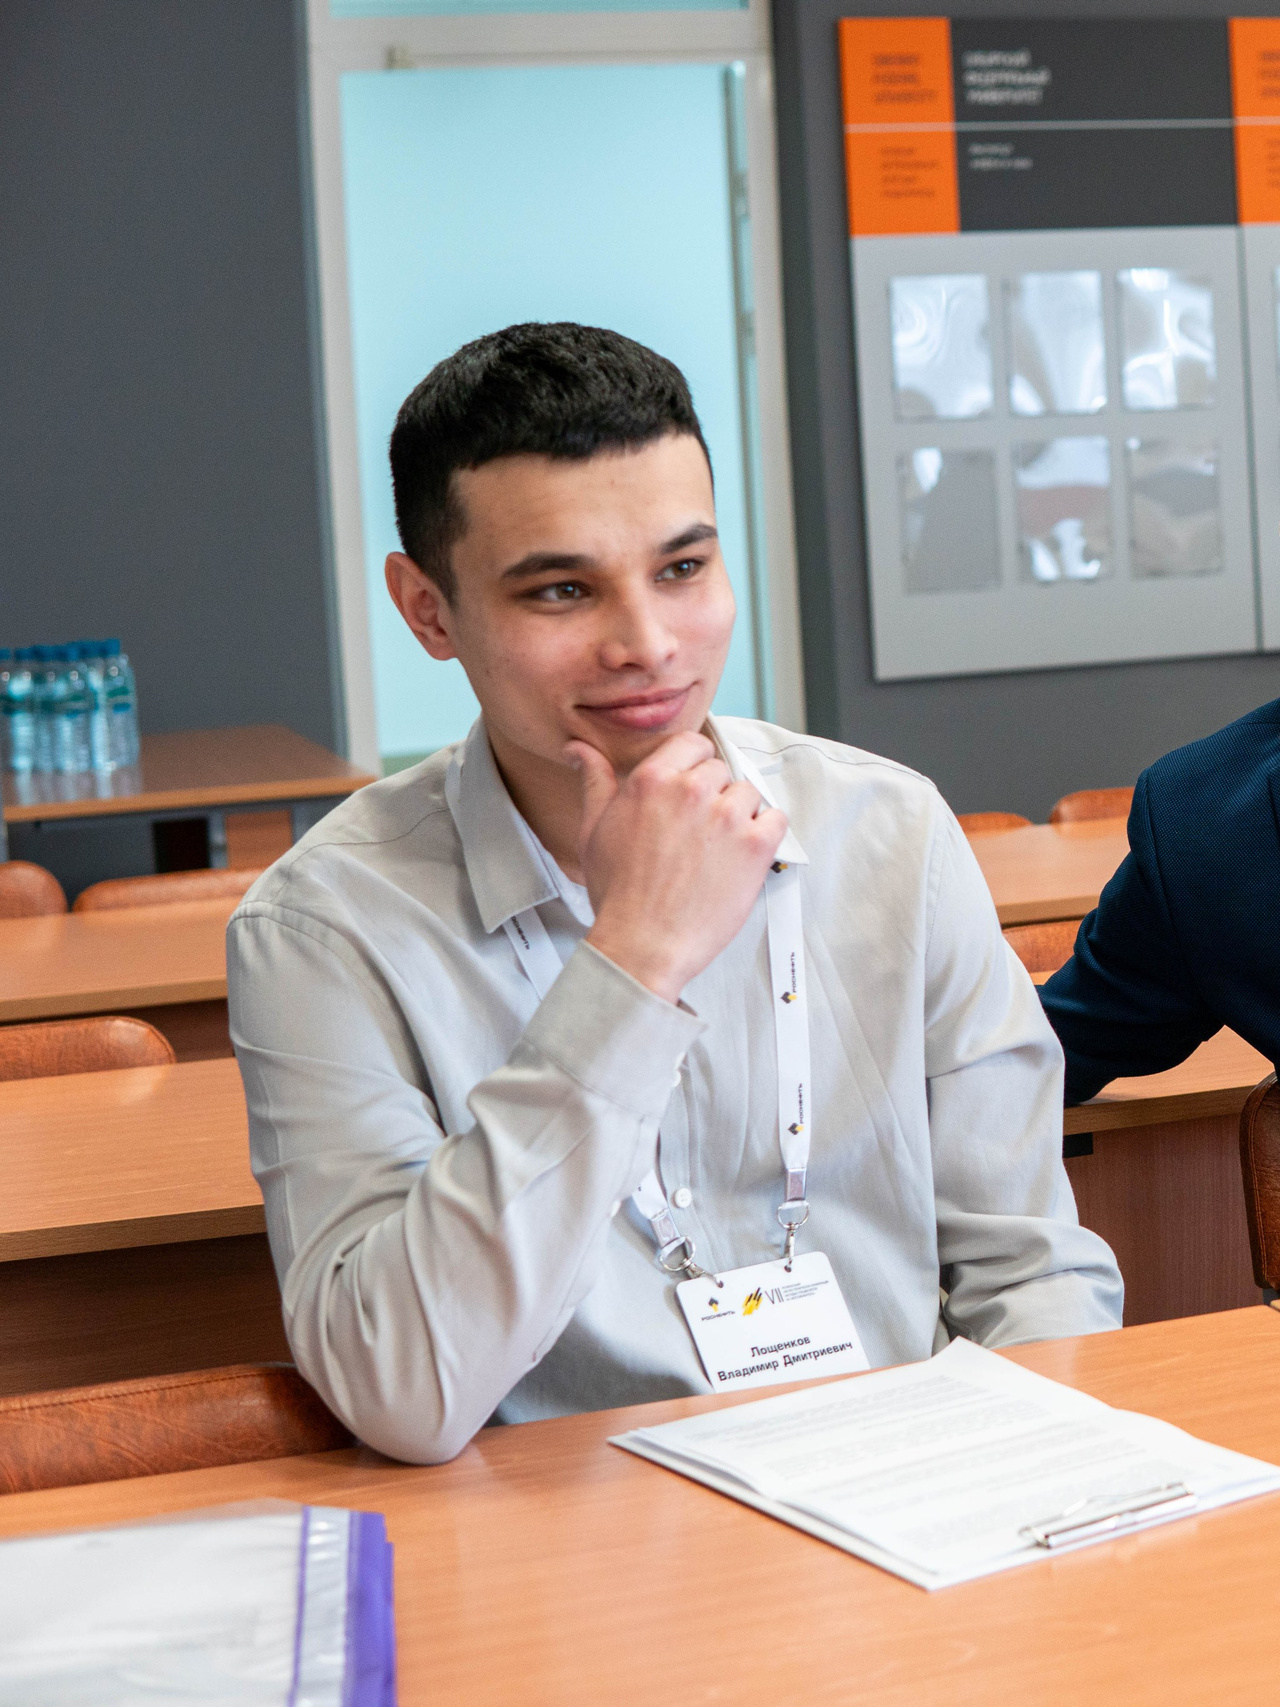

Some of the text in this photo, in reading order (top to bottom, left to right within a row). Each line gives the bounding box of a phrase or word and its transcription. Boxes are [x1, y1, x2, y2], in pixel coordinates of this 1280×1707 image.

[510, 915, 530, 950] ОСНЕФТЬ
[764, 1287, 784, 1305] VII
[701, 1310, 736, 1321] РОСНЕФТЬ
[751, 1336, 811, 1357] Лощенков
[717, 1341, 853, 1382] Владимир Дмитриевич
